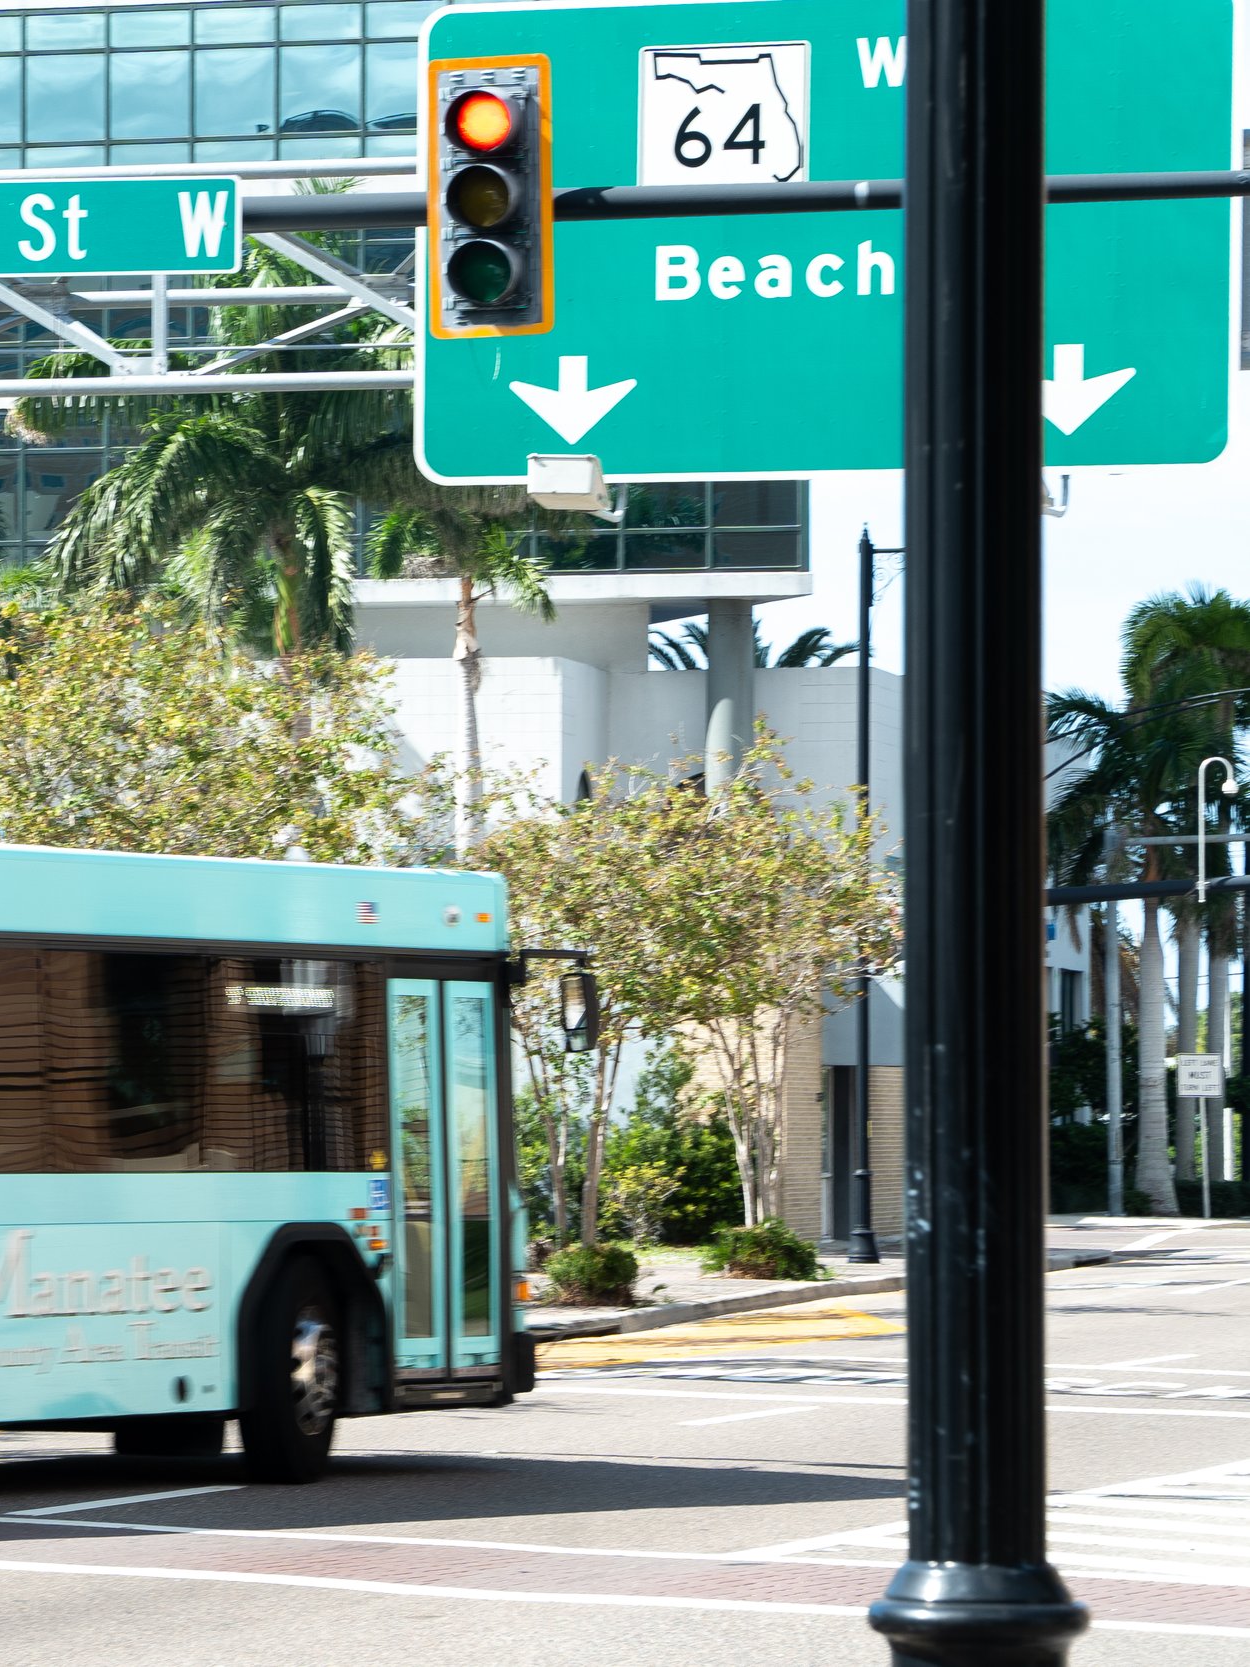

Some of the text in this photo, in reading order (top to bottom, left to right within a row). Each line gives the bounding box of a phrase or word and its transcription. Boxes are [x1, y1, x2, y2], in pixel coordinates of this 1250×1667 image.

[674, 103, 766, 168] 64
[18, 193, 88, 262] St
[178, 190, 229, 258] W
[655, 240, 895, 301] Beach
